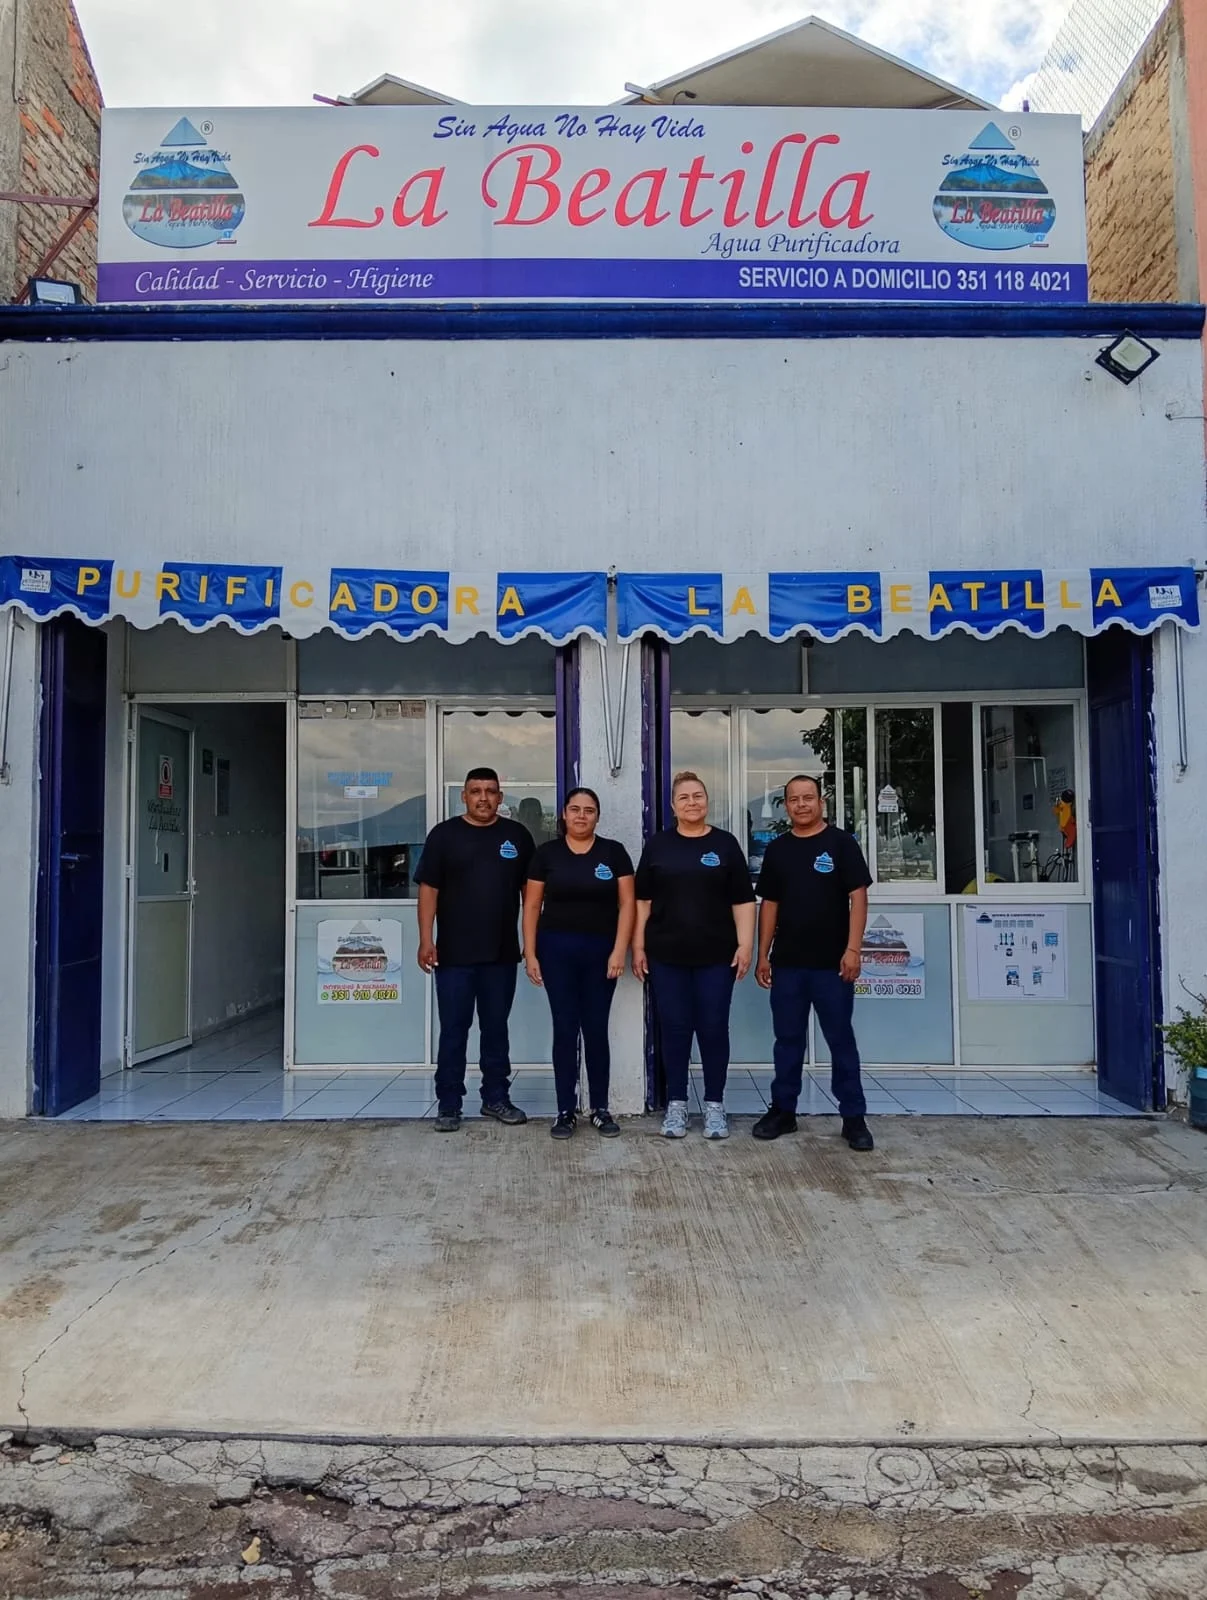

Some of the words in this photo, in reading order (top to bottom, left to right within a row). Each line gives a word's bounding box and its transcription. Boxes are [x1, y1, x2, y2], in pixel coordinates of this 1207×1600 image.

[433, 116, 476, 138] Sin
[483, 113, 547, 143] Agua
[554, 113, 588, 138] No
[594, 114, 646, 143] Hay
[651, 115, 706, 138] Vida
[307, 144, 448, 229] La
[481, 133, 875, 230] Beatilla
[139, 198, 163, 222] La
[168, 195, 233, 222] Beatilla
[950, 200, 975, 224] La
[978, 199, 1044, 224] Beatilla
[701, 232, 761, 258] Agua
[767, 231, 900, 259] Purificadora
[135, 267, 224, 293] Calidad
[240, 268, 327, 291] Servicio
[346, 266, 433, 295] Higiene
[739, 267, 828, 288] SERVICIO
[833, 268, 847, 288] A
[852, 269, 950, 290] DOMICILIO
[957, 270, 987, 290] 351
[994, 271, 1025, 291] 118
[1030, 271, 1071, 291] 4021
[76, 566, 525, 616] PURIFICADORA
[688, 584, 757, 616] LA
[847, 578, 1122, 613] BEATILLA
